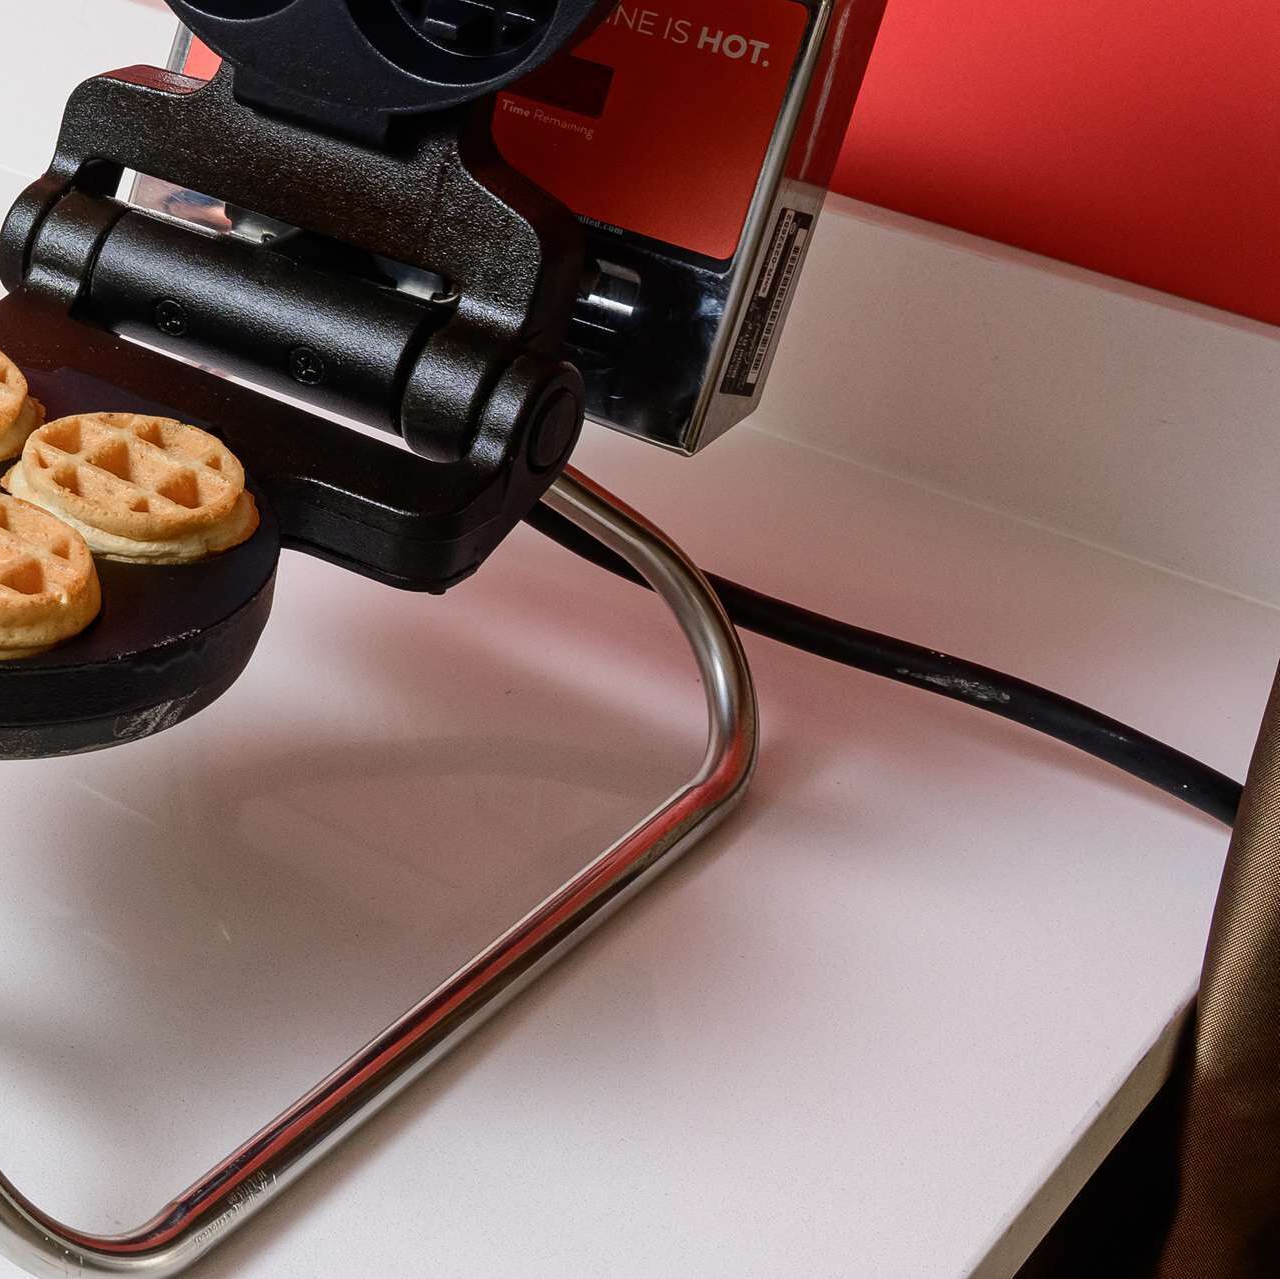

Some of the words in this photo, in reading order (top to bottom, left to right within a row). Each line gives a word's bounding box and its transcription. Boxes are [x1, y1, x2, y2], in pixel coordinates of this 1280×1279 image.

[663, 16, 692, 45] IS
[696, 25, 770, 68] HOT.
[502, 98, 531, 118] Time
[532, 108, 594, 141] Remaining
